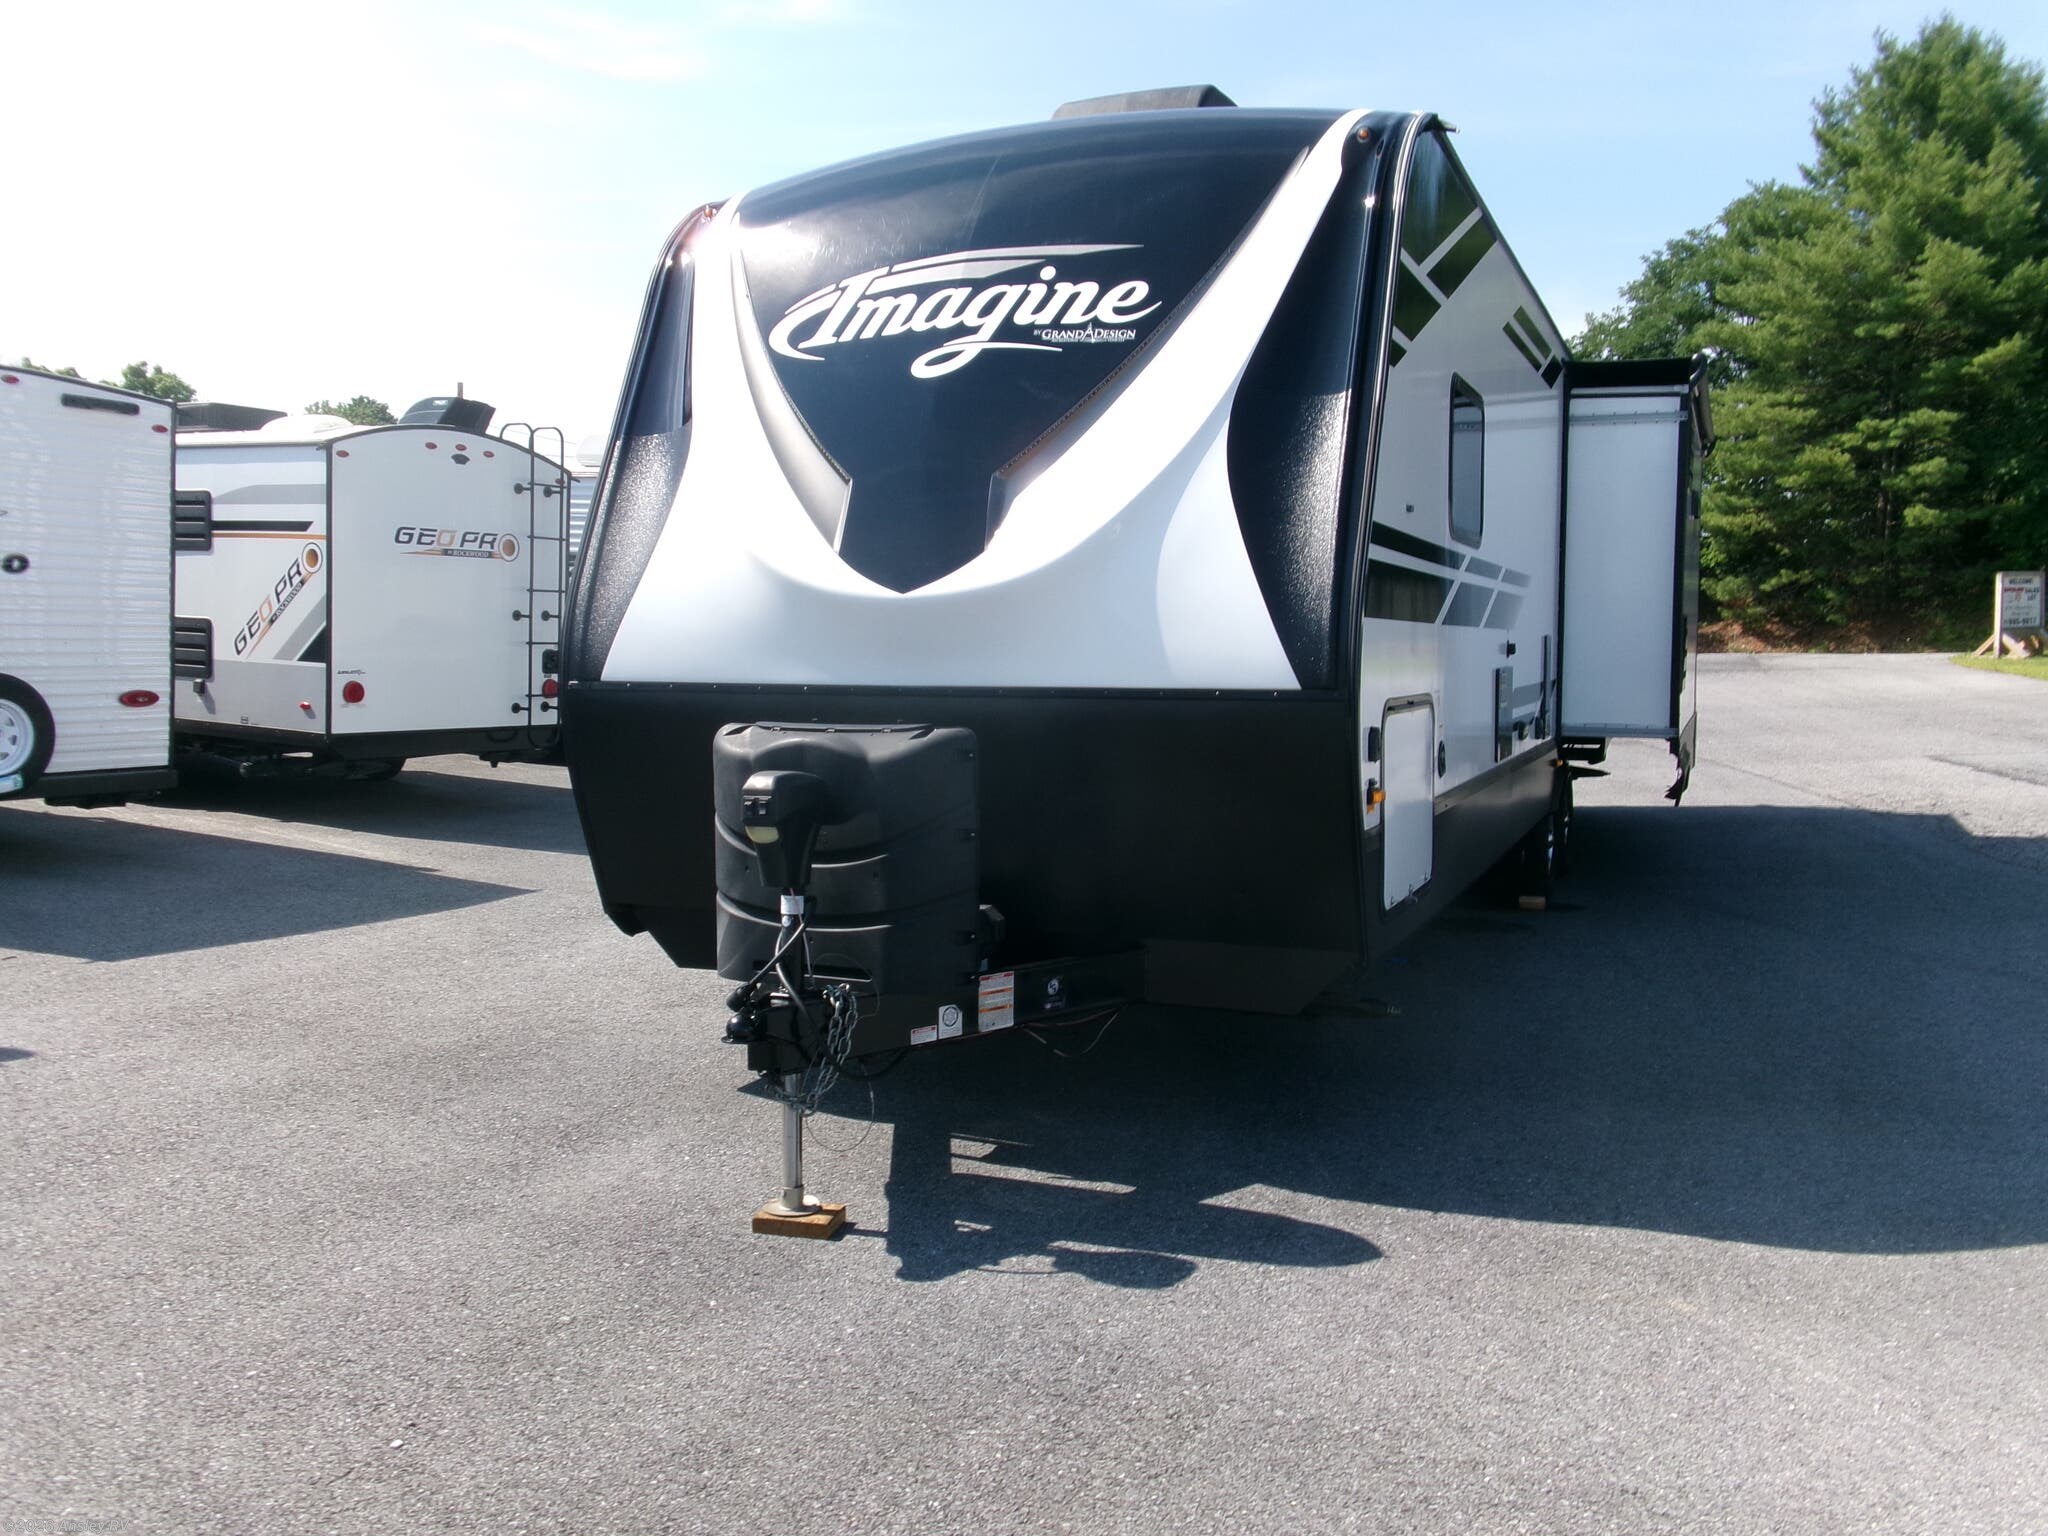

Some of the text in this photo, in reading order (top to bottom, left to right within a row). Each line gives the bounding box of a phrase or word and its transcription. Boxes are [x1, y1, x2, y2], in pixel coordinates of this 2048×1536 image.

[768, 264, 1162, 378] Imagine
[1042, 328, 1084, 340] GRAND
[1094, 328, 1137, 340] DESIGN
[394, 526, 457, 546] GEO
[234, 595, 273, 656] GEO
